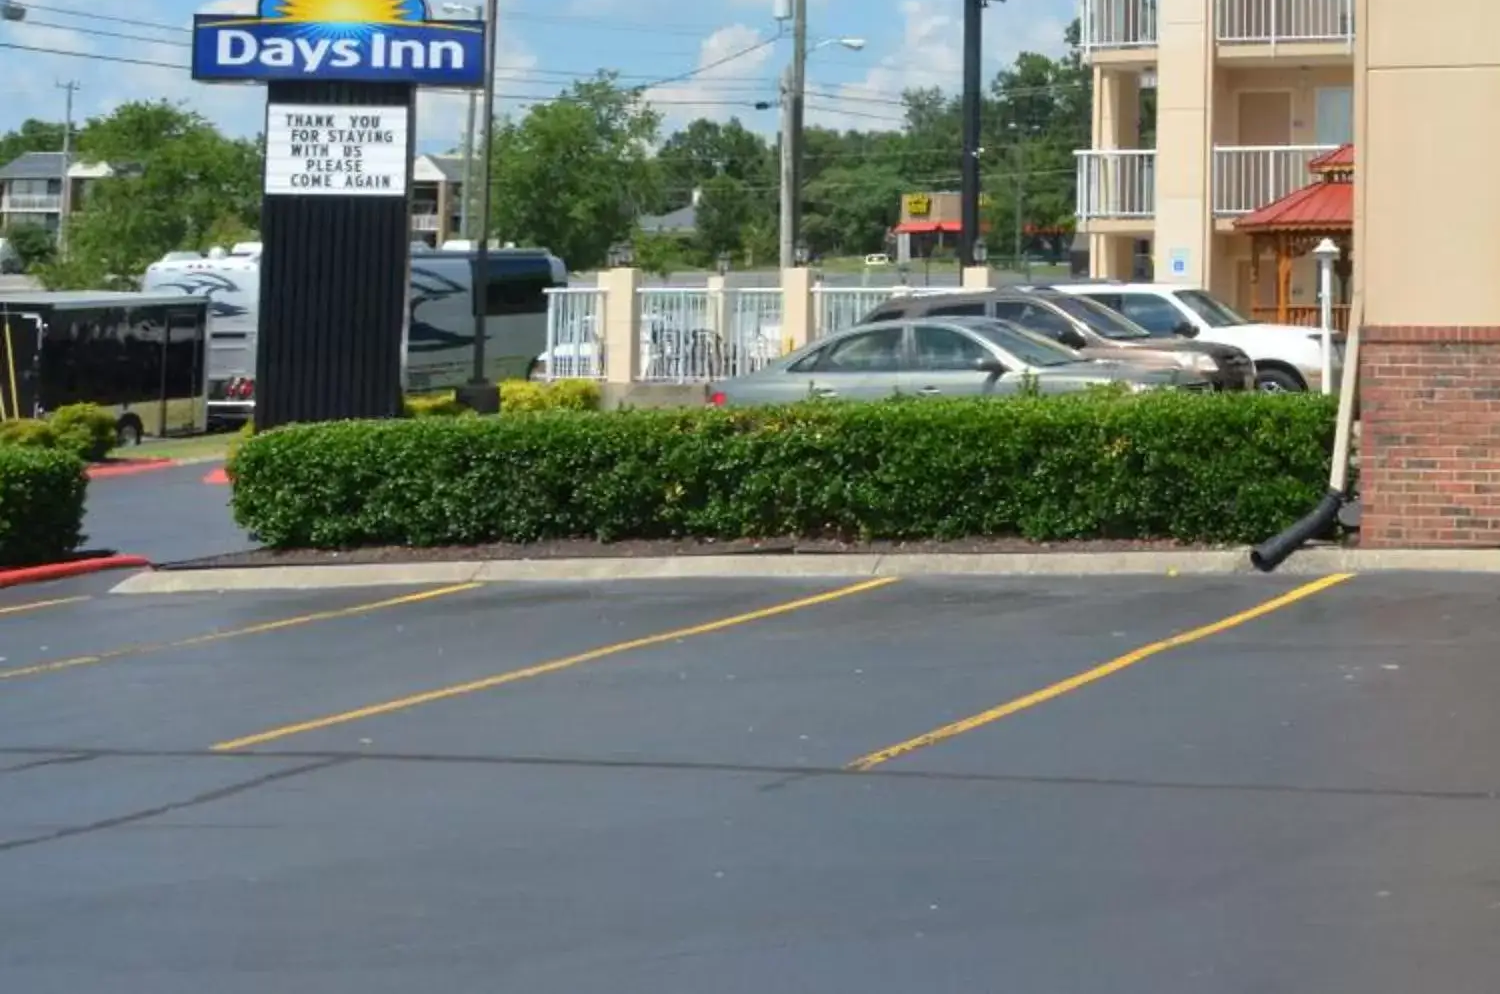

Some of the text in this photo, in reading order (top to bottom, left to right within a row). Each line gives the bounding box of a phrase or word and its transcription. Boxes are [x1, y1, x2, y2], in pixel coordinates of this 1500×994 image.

[217, 29, 465, 72] Days Inn
[286, 113, 381, 128] THANK YOU
[291, 129, 393, 143] FOR STAYING
[291, 144, 362, 157] WITH US
[306, 159, 363, 172] PLEASE
[290, 174, 391, 188] COME AGAIN
